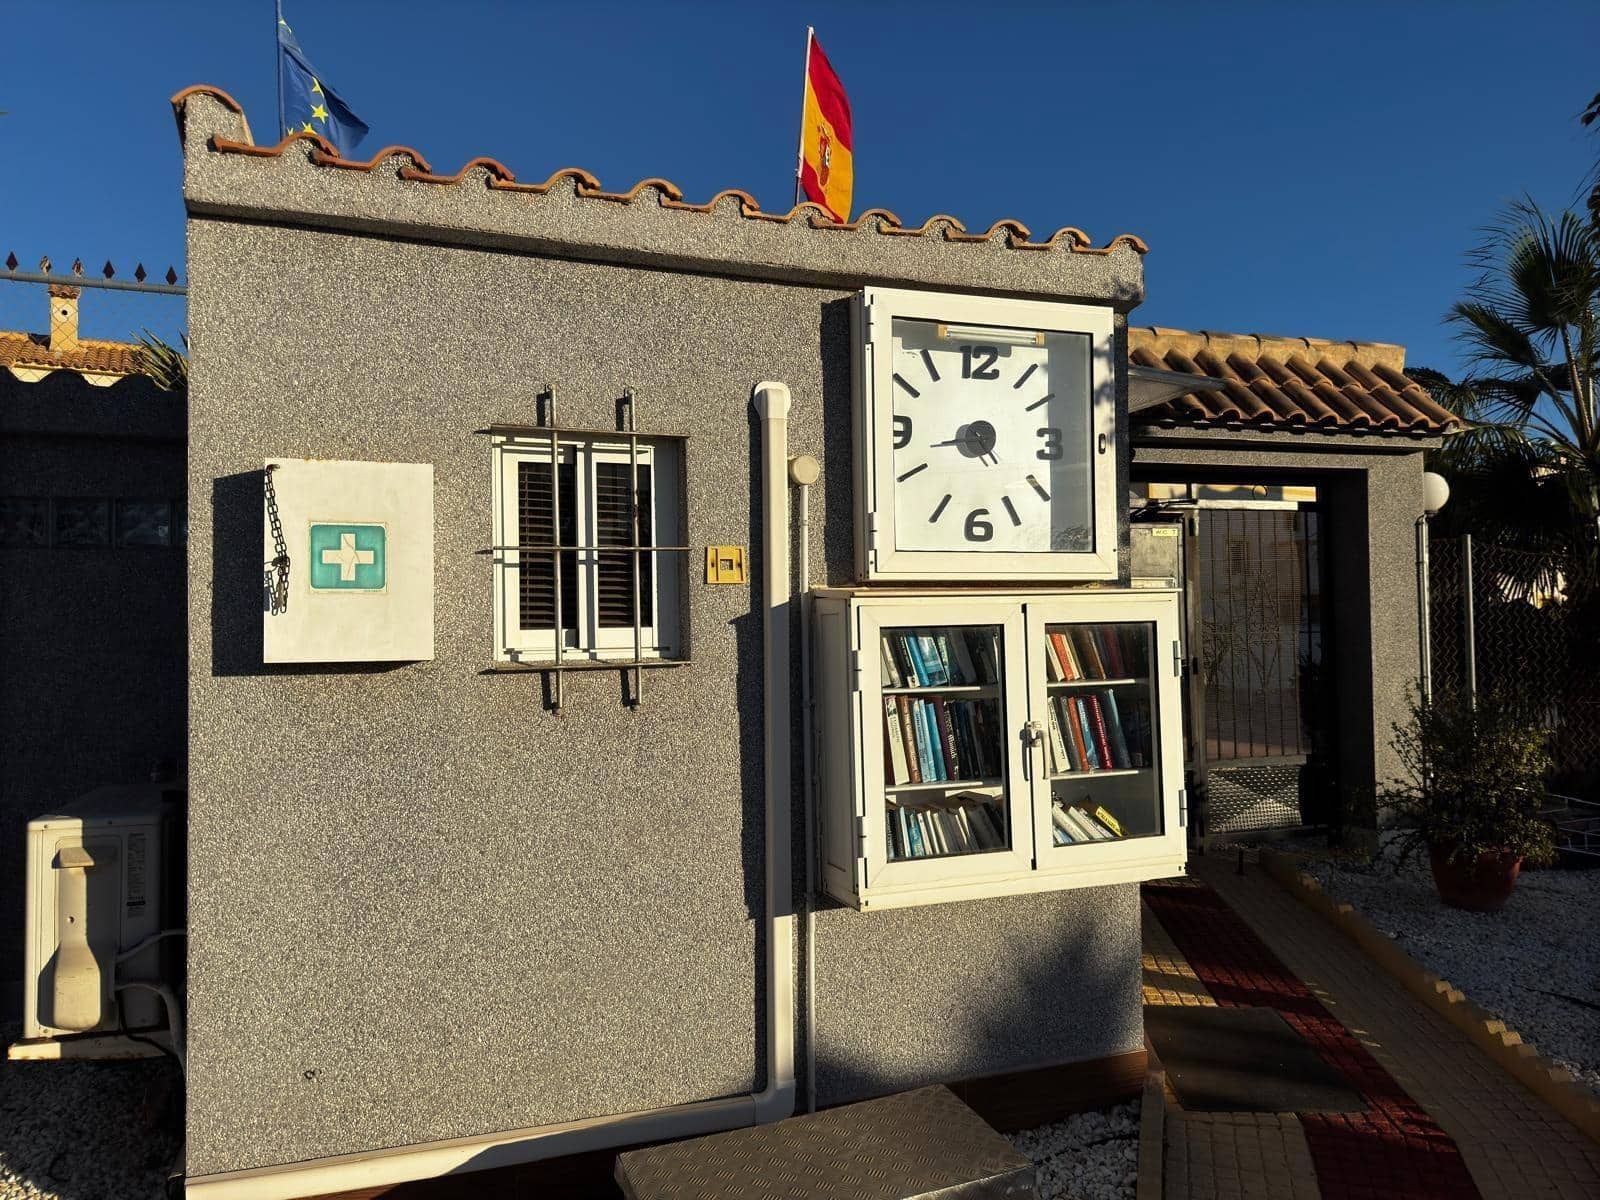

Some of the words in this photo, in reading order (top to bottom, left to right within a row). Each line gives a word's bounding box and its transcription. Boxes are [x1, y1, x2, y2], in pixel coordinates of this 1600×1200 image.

[959, 345, 1000, 381] 12
[893, 414, 913, 450] 9
[1036, 427, 1064, 461] 3
[963, 508, 994, 542] 6
